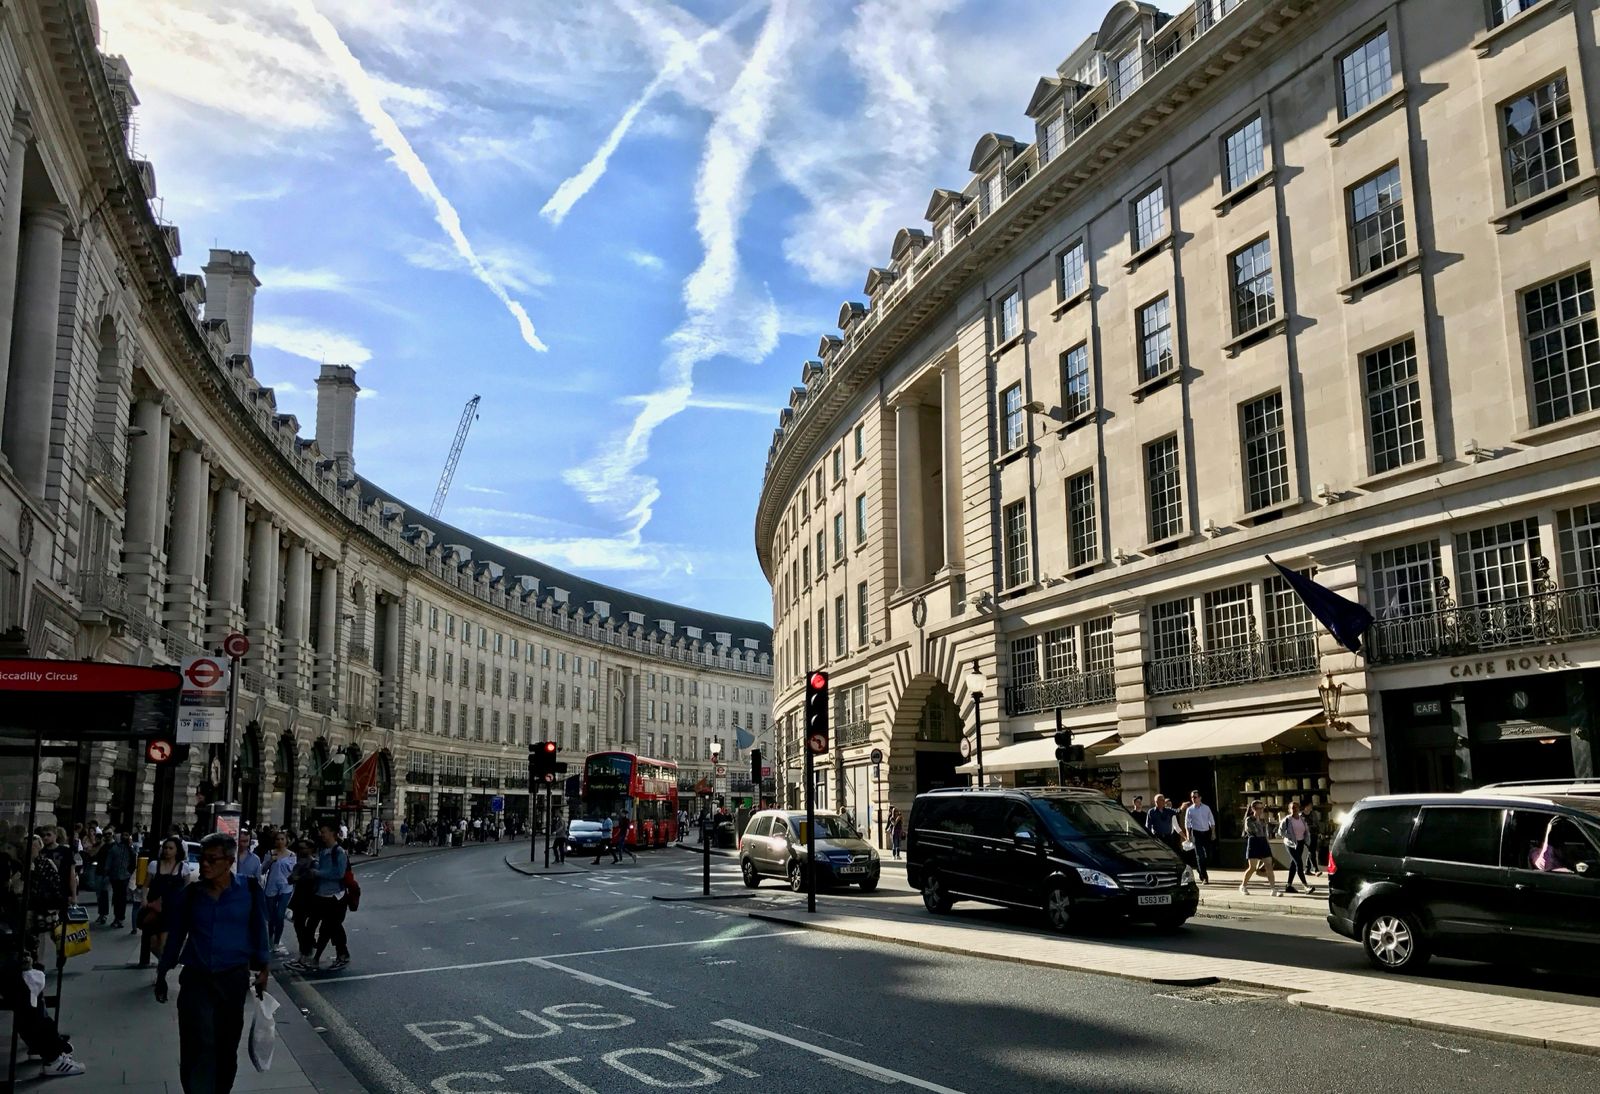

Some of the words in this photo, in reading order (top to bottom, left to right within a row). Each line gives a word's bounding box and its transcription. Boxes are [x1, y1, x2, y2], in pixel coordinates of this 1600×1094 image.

[228, 637, 245, 655] C
[1450, 661, 1496, 678] CAFE
[1506, 652, 1574, 671] ROYAL
[45, 671, 79, 681] Circus
[1415, 703, 1439, 713] CAFE
[1140, 896, 1157, 904] LS63
[1157, 895, 1169, 903] XFY
[405, 1002, 637, 1052] BUS
[431, 1038, 761, 1094] STOP
